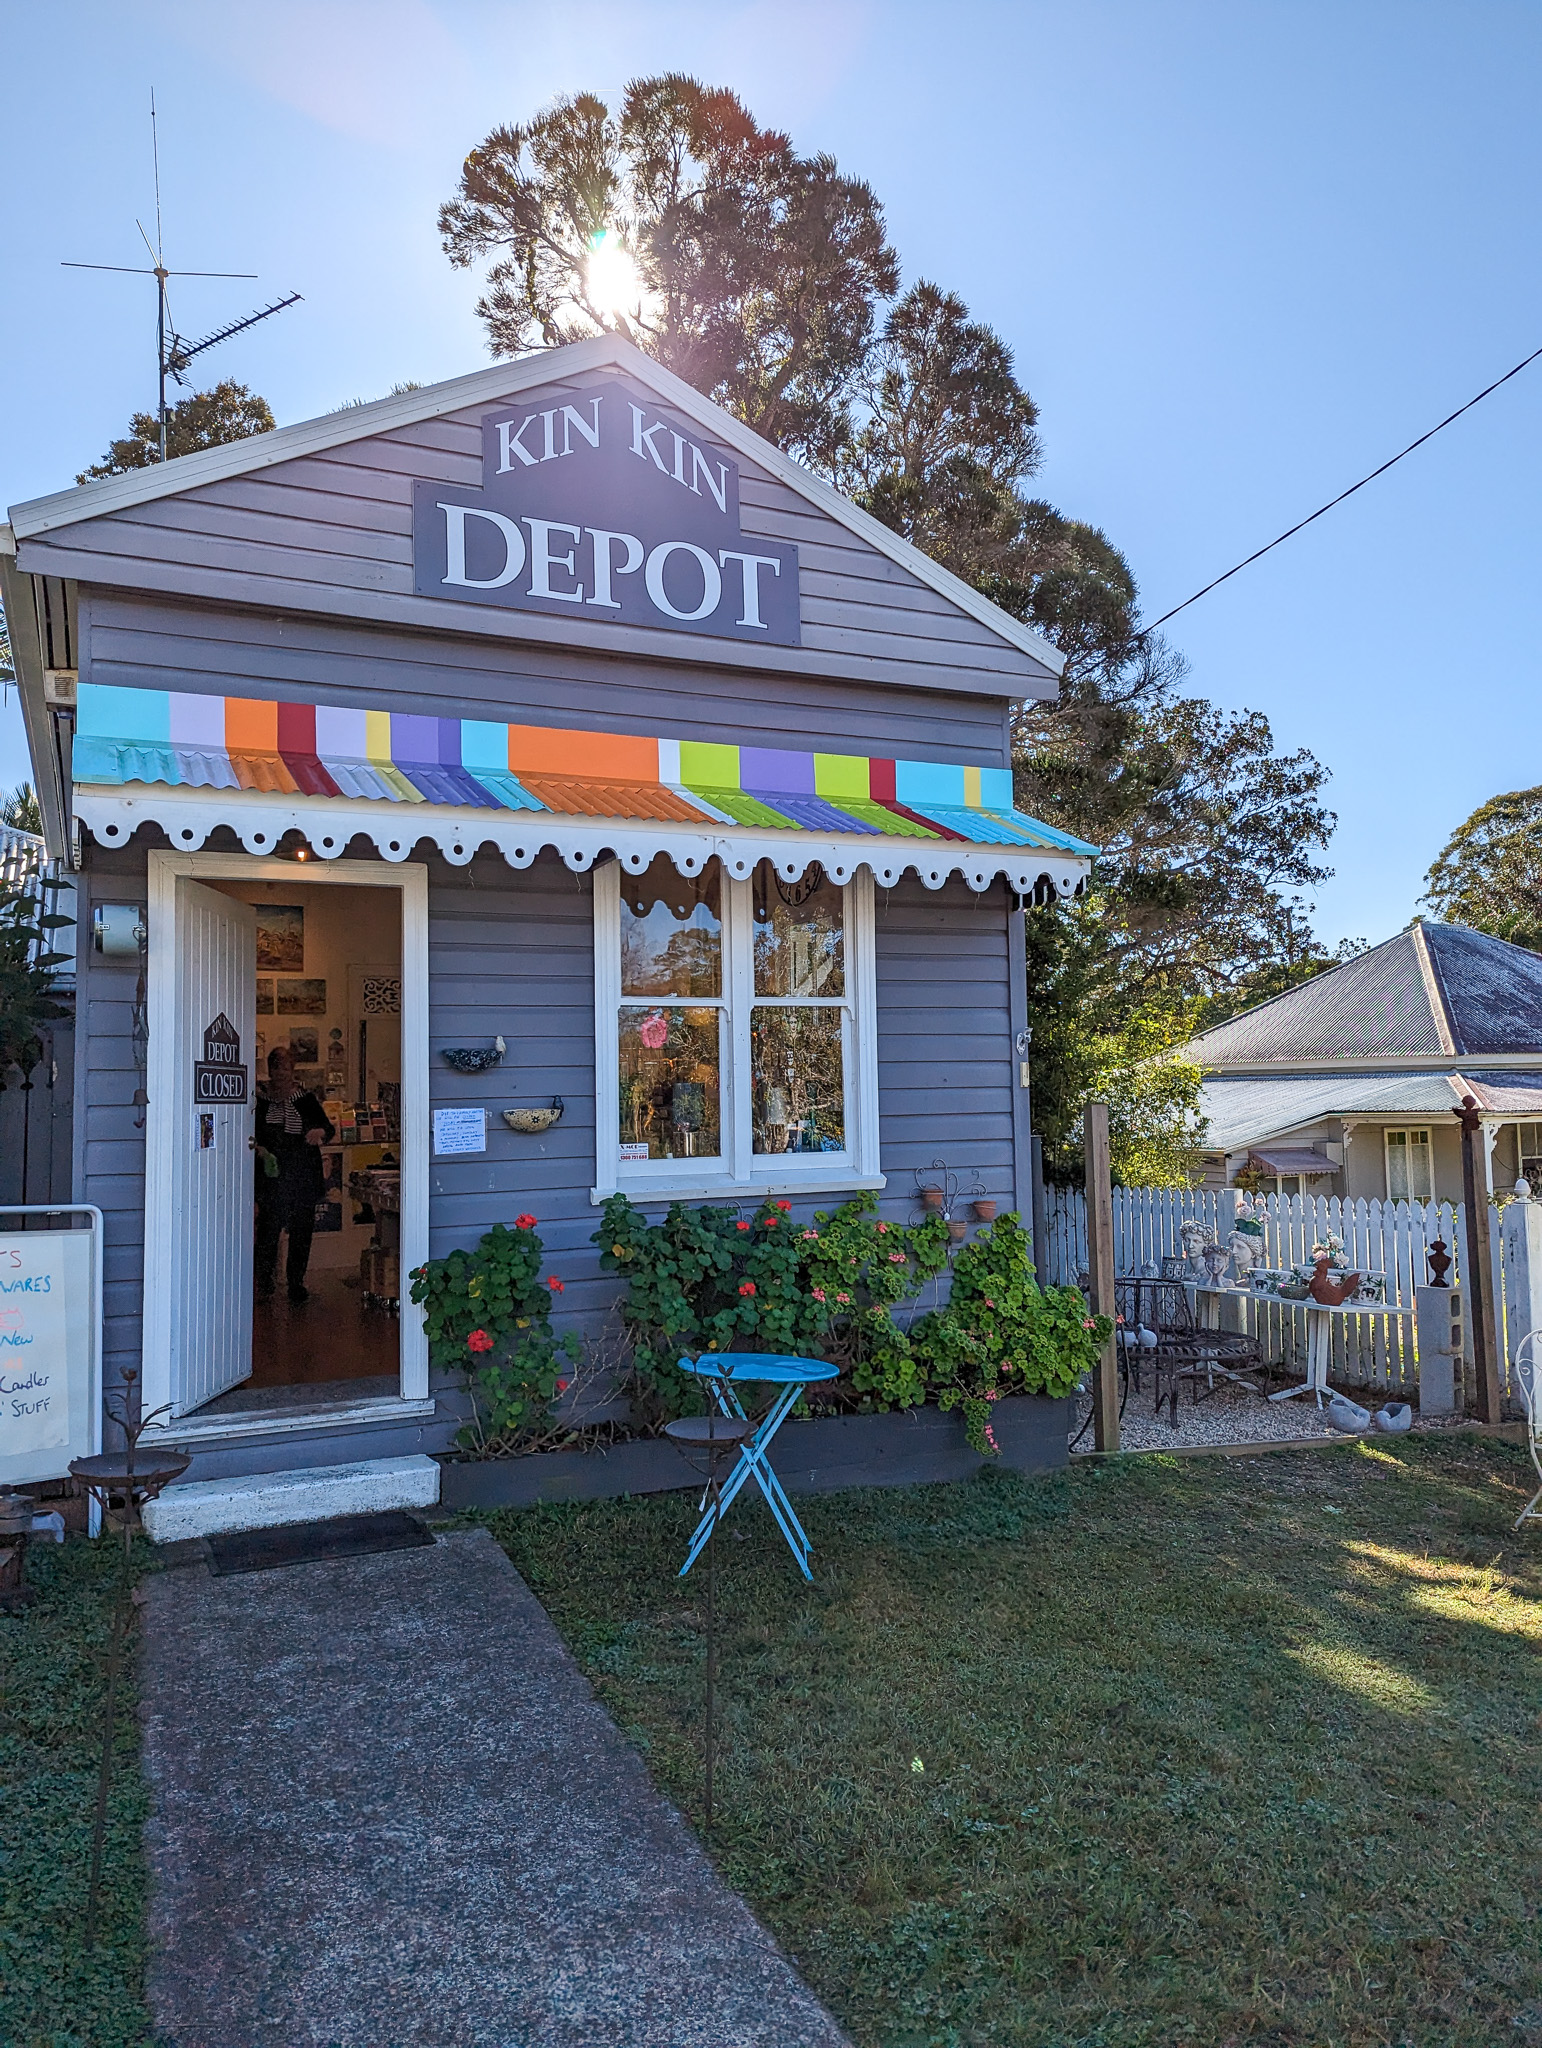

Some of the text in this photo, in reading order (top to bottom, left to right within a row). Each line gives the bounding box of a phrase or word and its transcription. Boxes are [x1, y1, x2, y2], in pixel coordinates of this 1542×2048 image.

[495, 396, 729, 514] KIN KIN
[436, 501, 781, 629] DEPOT
[207, 1041, 238, 1062] DEPOT
[200, 1072, 243, 1097] CLOSED
[0, 1275, 50, 1293] WARES
[0, 1330, 33, 1346] New
[11, 1397, 50, 1417] STUFF
